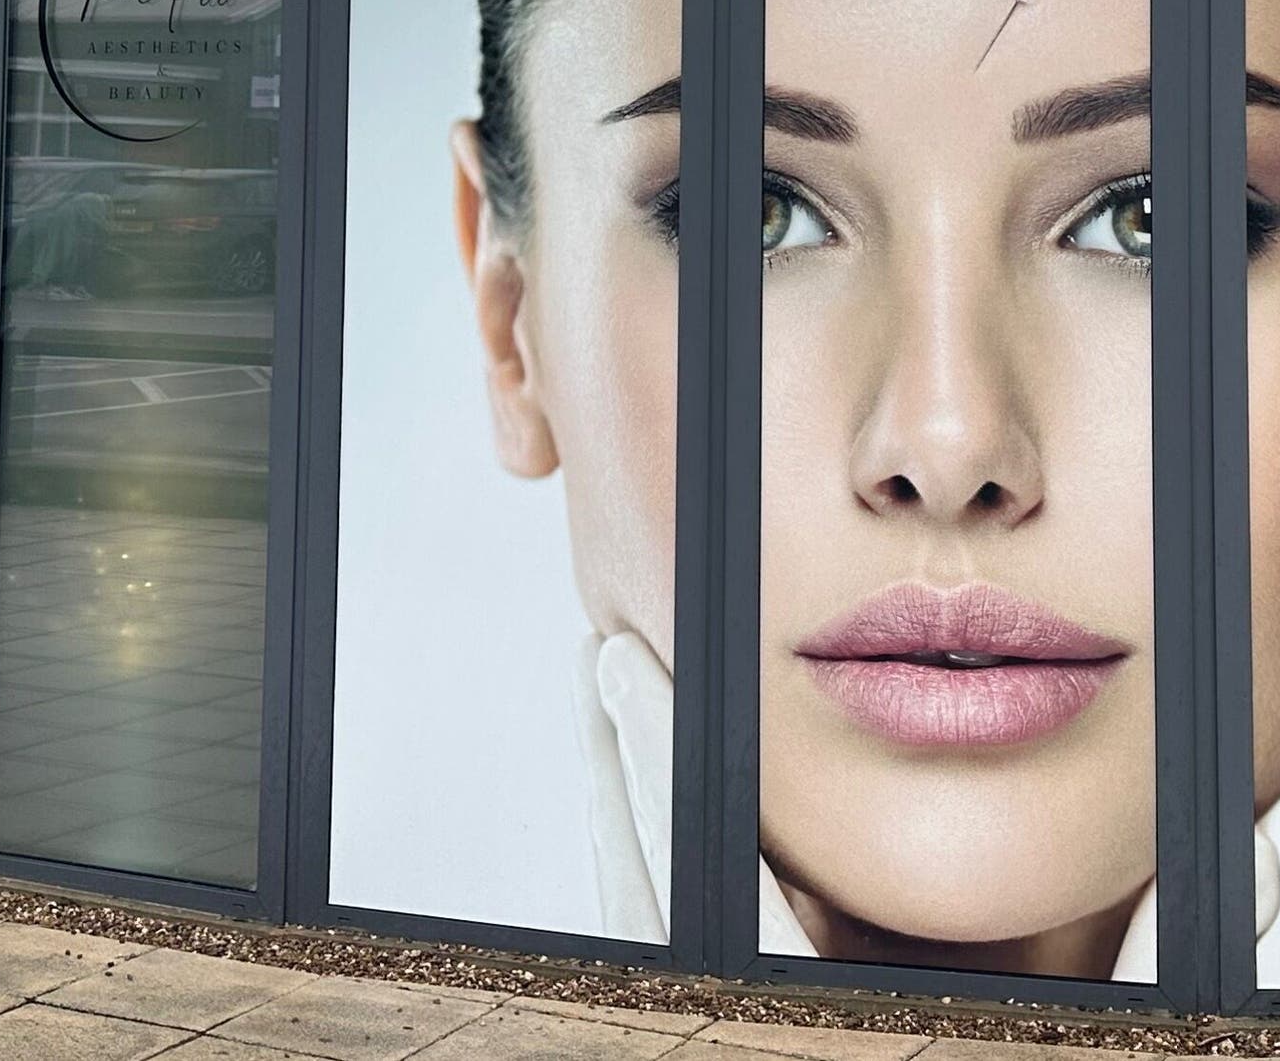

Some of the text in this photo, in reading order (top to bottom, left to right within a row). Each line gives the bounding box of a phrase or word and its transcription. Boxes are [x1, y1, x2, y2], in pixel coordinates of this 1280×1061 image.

[88, 40, 241, 54] AESTHETICS
[156, 64, 168, 76] &
[109, 87, 205, 100] BEAUTY
